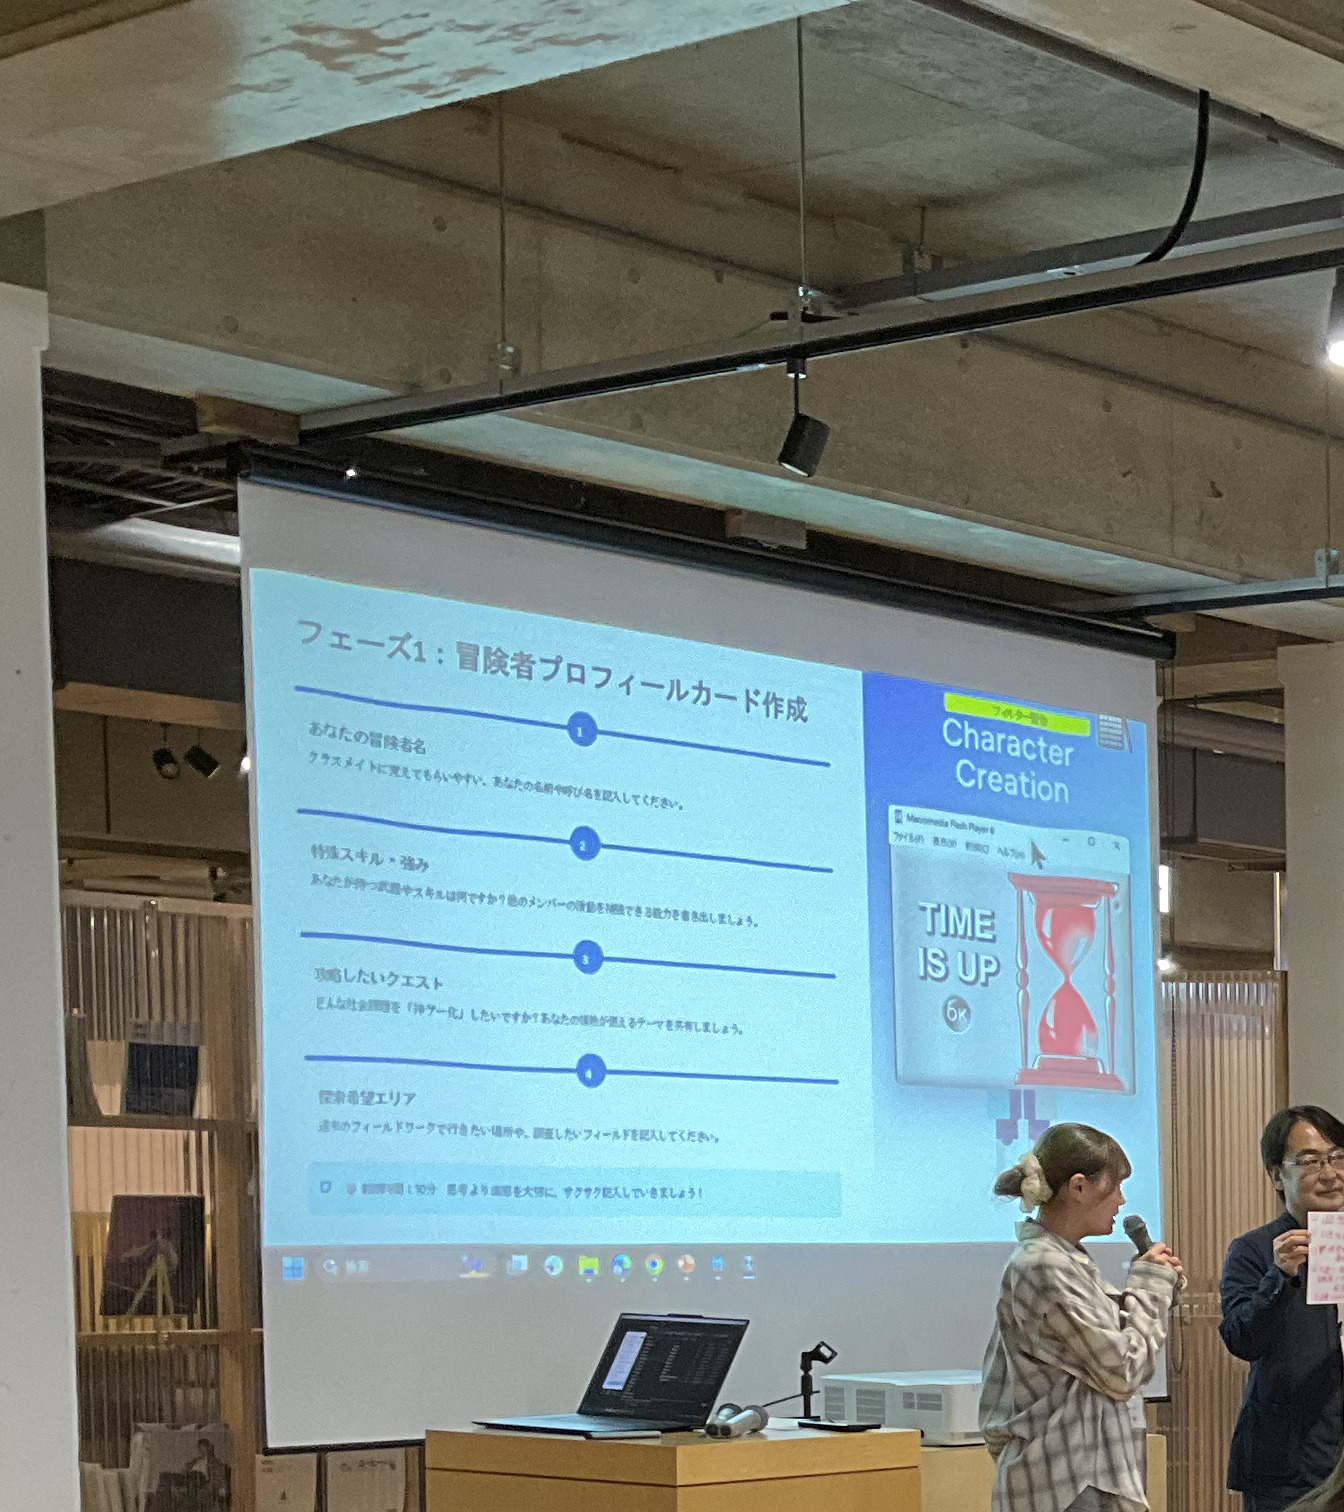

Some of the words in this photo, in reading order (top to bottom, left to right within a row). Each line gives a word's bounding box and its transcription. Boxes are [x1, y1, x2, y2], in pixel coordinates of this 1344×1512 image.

[308, 721, 427, 755] あなたの冒険者名
[577, 726, 584, 738] 1
[942, 717, 1075, 767] Character
[955, 758, 1070, 804] Creation
[917, 900, 997, 944] TIME
[918, 946, 949, 983] IS
[956, 950, 1001, 988] UP
